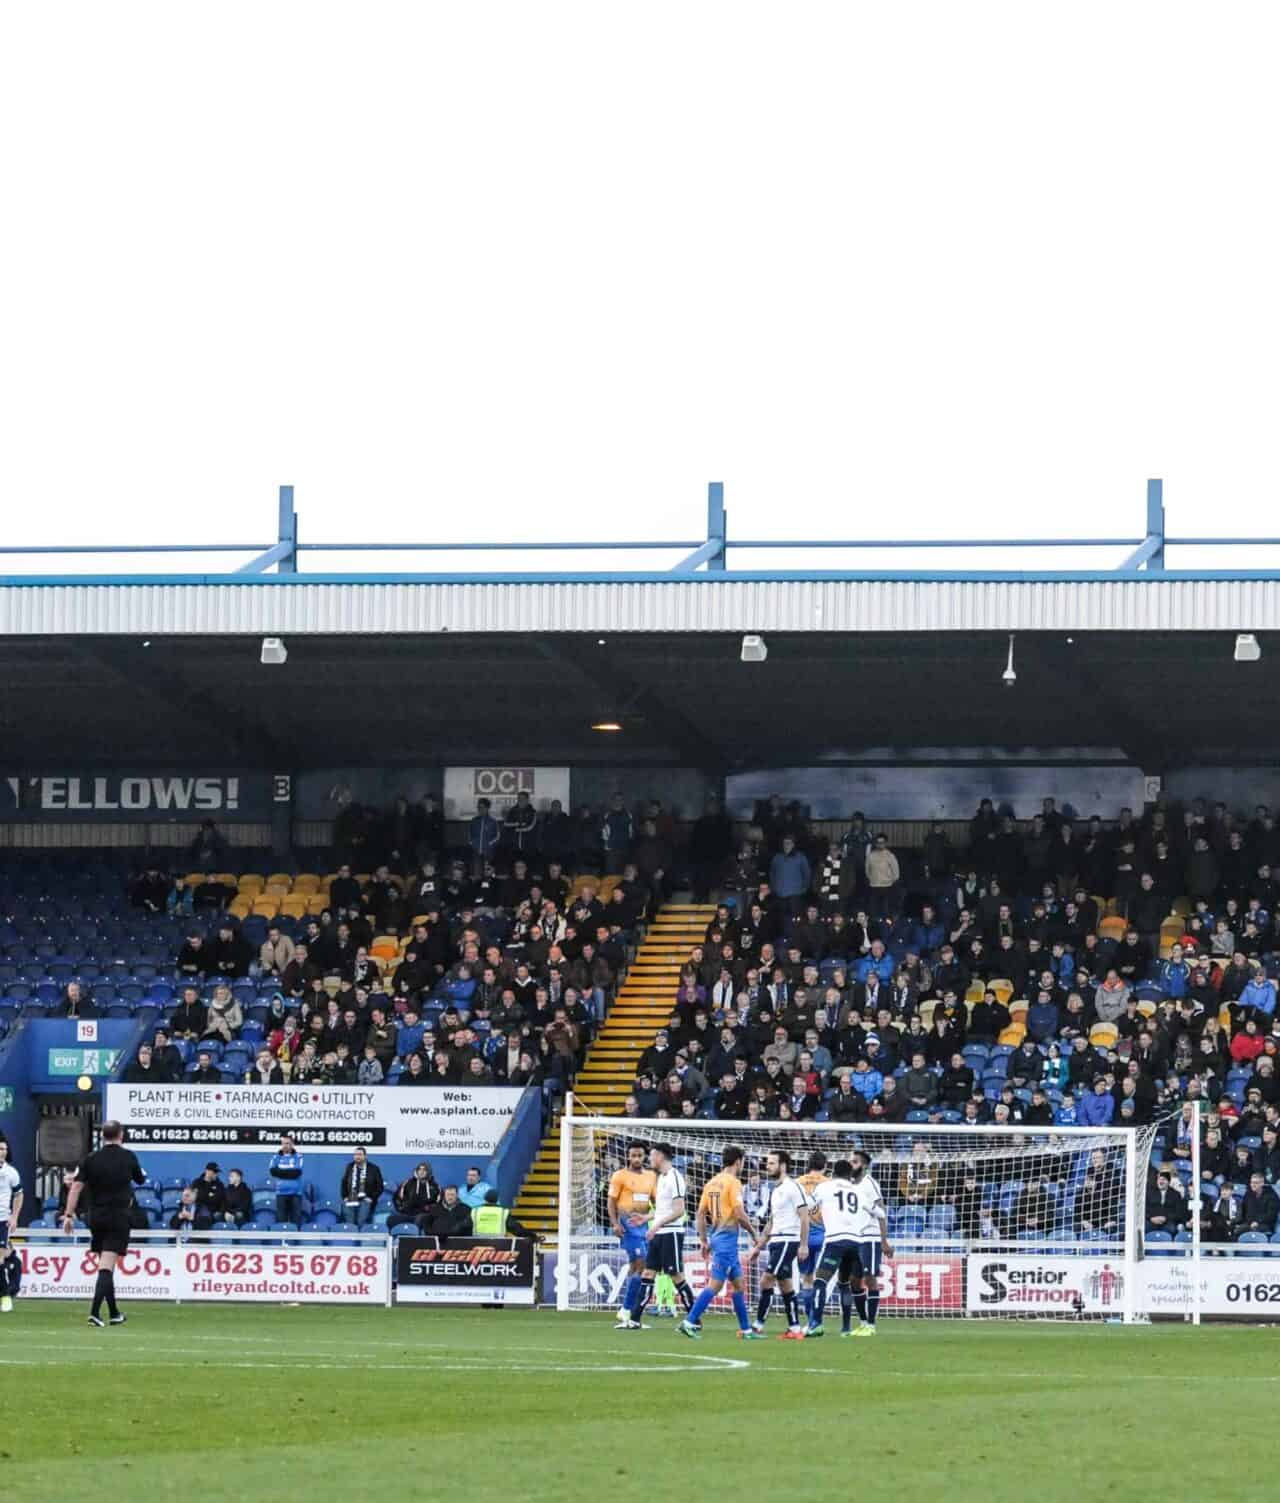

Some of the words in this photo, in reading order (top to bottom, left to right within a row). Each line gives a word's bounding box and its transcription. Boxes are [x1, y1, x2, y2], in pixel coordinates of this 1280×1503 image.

[478, 770, 533, 793] OCL
[81, 1025, 94, 1037] 19
[54, 1055, 79, 1068] EXIT
[128, 1090, 174, 1103] PLANT
[178, 1091, 211, 1104] HIRE
[224, 1091, 310, 1105] TARMACING
[321, 1092, 375, 1105] UTILITY
[443, 1092, 473, 1102] Web:
[130, 1107, 170, 1118] SEWER
[174, 1108, 181, 1118] &
[184, 1108, 213, 1119] CIVIL
[215, 1108, 293, 1119] ENGINEERING
[296, 1109, 376, 1120] CONTRACTOR
[400, 1105, 514, 1117] www.asplant.co.uk
[128, 1128, 149, 1140] Tel.
[152, 1129, 190, 1140] 01623
[193, 1129, 238, 1141] 624816
[327, 1131, 374, 1142] 662060
[405, 1138, 498, 1150] info@asplant.co.
[834, 1190, 858, 1214] 19
[117, 1250, 171, 1276] Co.
[186, 1252, 263, 1275] 01623
[273, 1255, 305, 1276] 55
[310, 1255, 341, 1276] 67
[346, 1255, 378, 1277] 68
[41, 1283, 95, 1295] Decoratin
[114, 1286, 170, 1296] ontractors
[192, 1279, 370, 1296] rileyandcoltd.co.uk
